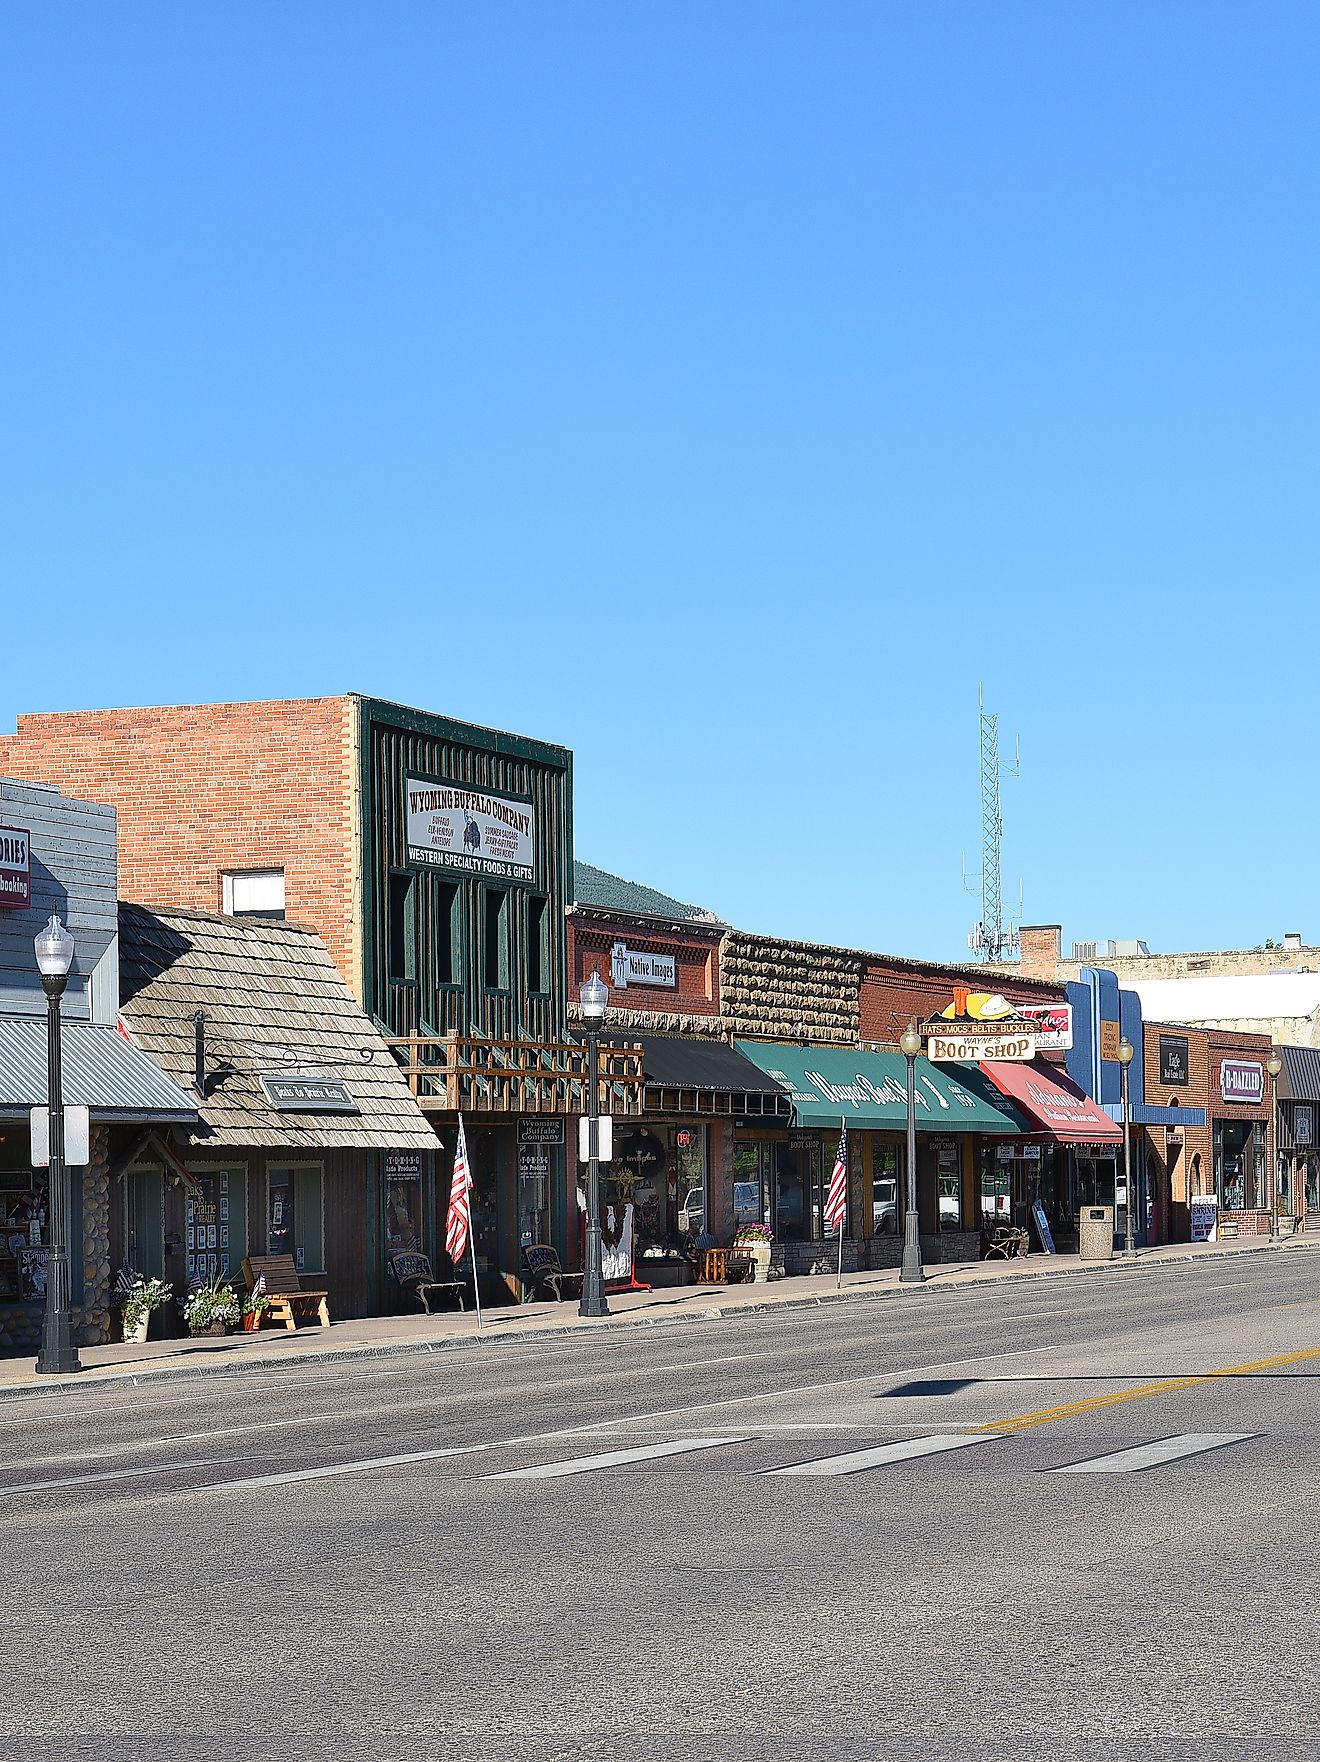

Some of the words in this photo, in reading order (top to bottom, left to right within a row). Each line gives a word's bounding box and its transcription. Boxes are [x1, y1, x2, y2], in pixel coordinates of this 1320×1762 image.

[409, 789, 453, 814] WYOMING
[453, 791, 492, 816] BUFFALO
[492, 801, 530, 837] COMPANY
[408, 846, 443, 865] WESTERN
[444, 853, 482, 871] SPECIALTY
[483, 860, 506, 875] FOODS
[506, 865, 513, 876] &
[513, 866, 533, 880] GIFTS
[629, 956, 650, 976] Native
[651, 959, 674, 982] Images
[922, 1025, 942, 1034] HATS
[945, 1025, 968, 1034] MOCS
[972, 1024, 997, 1033] BELTS
[1000, 1023, 1035, 1033] BUCKLES
[963, 1036, 1002, 1045] WAYNE'S
[934, 1039, 979, 1058] BOOT
[984, 1039, 1030, 1058] SHOP
[1225, 1069, 1260, 1090] B-DAZZLED
[804, 1070, 871, 1109] Wayne's
[522, 1120, 560, 1129] Wyoming
[526, 1127, 556, 1135] Buffalo
[521, 1133, 560, 1142] Company
[805, 1140, 819, 1149] SHOP
[193, 1201, 217, 1215] Prairie
[1192, 1206, 1216, 1215] SHRINE
[22, 1252, 49, 1264] Stampe
